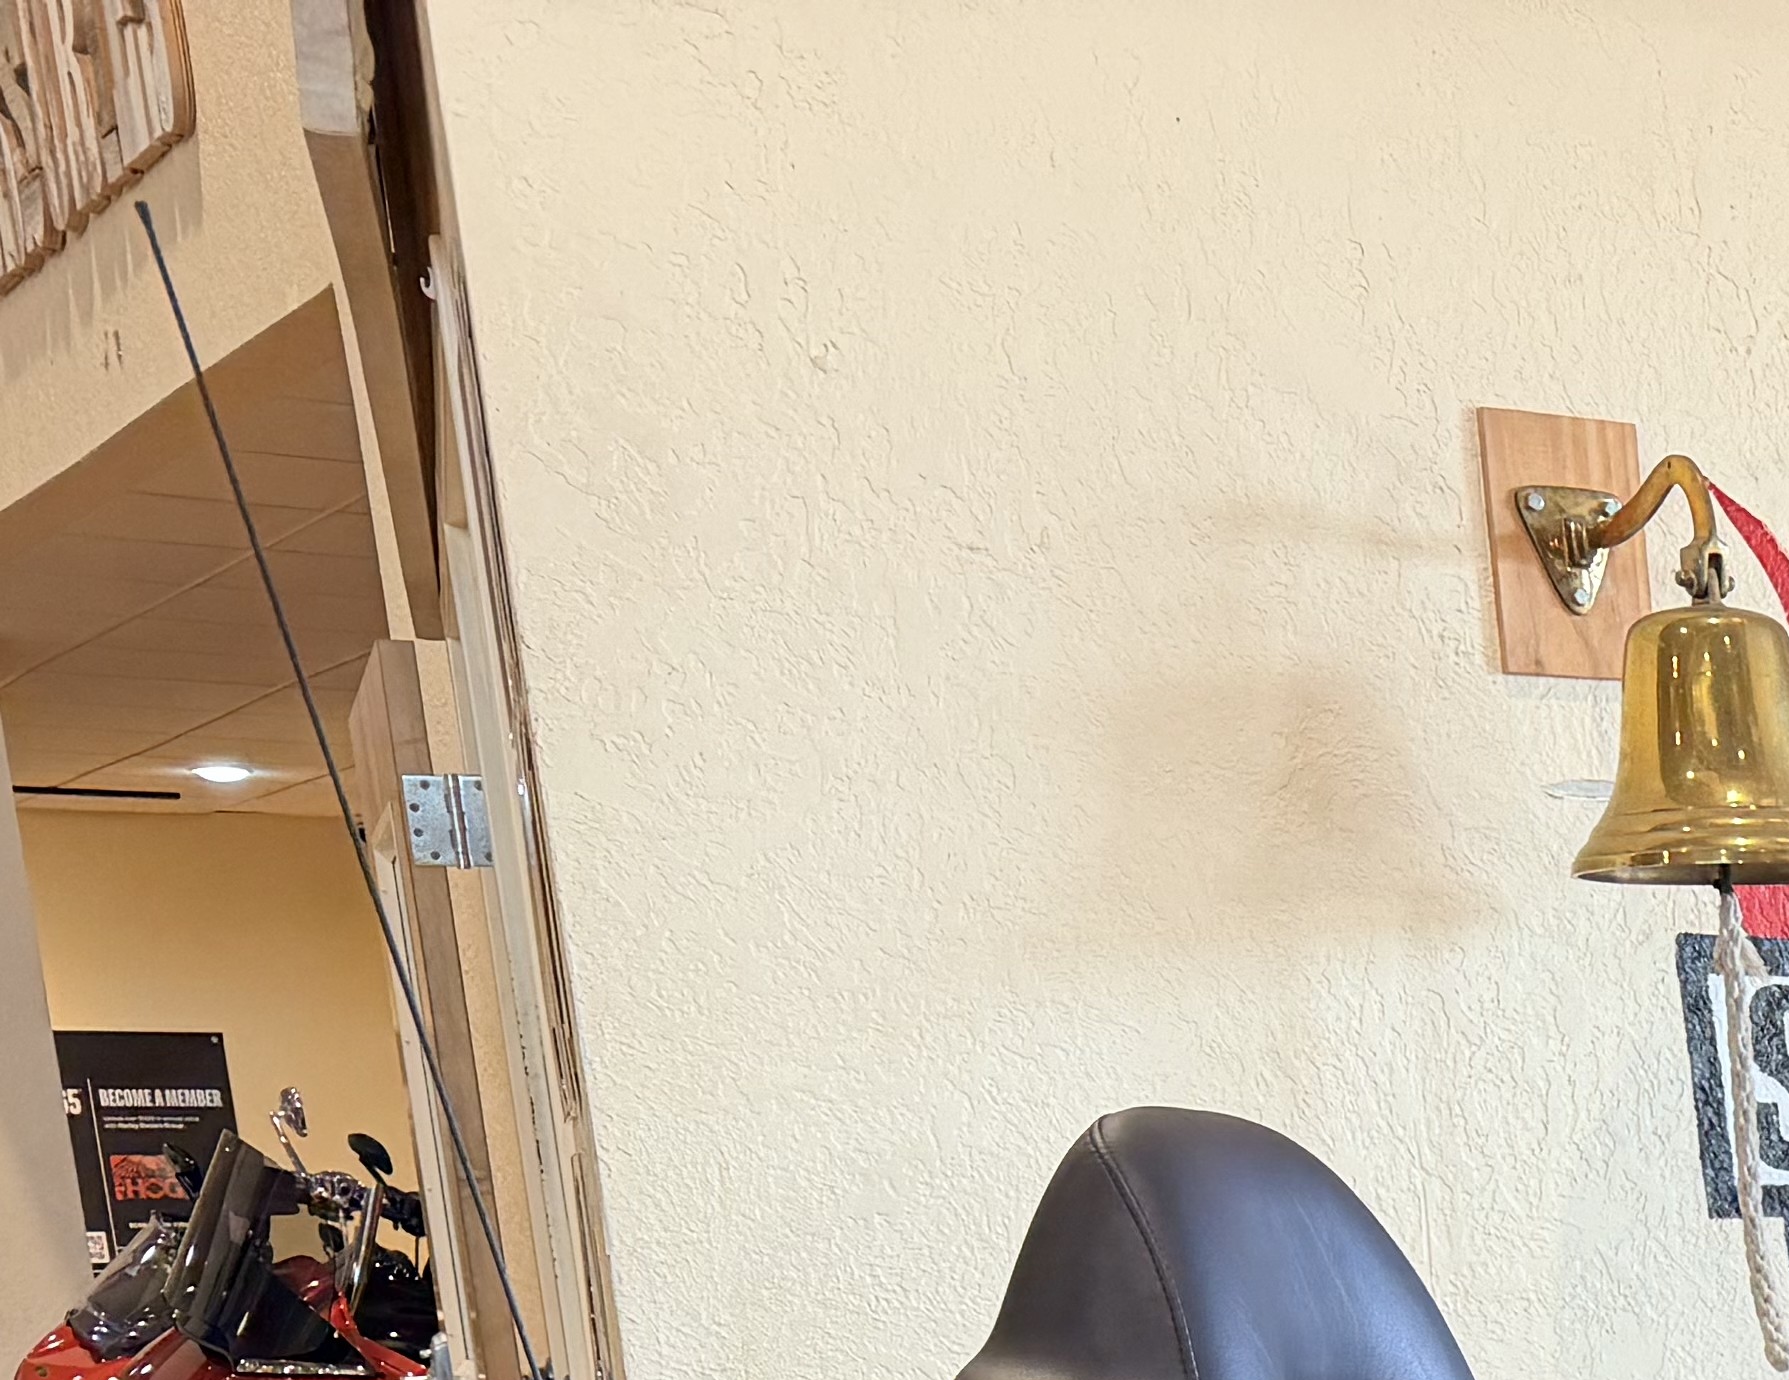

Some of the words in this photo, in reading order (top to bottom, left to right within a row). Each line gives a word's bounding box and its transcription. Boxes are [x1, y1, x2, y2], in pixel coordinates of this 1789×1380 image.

[98, 1088, 152, 1108] BECOME
[154, 1088, 165, 1108] A
[165, 1088, 223, 1108] MEMBER
